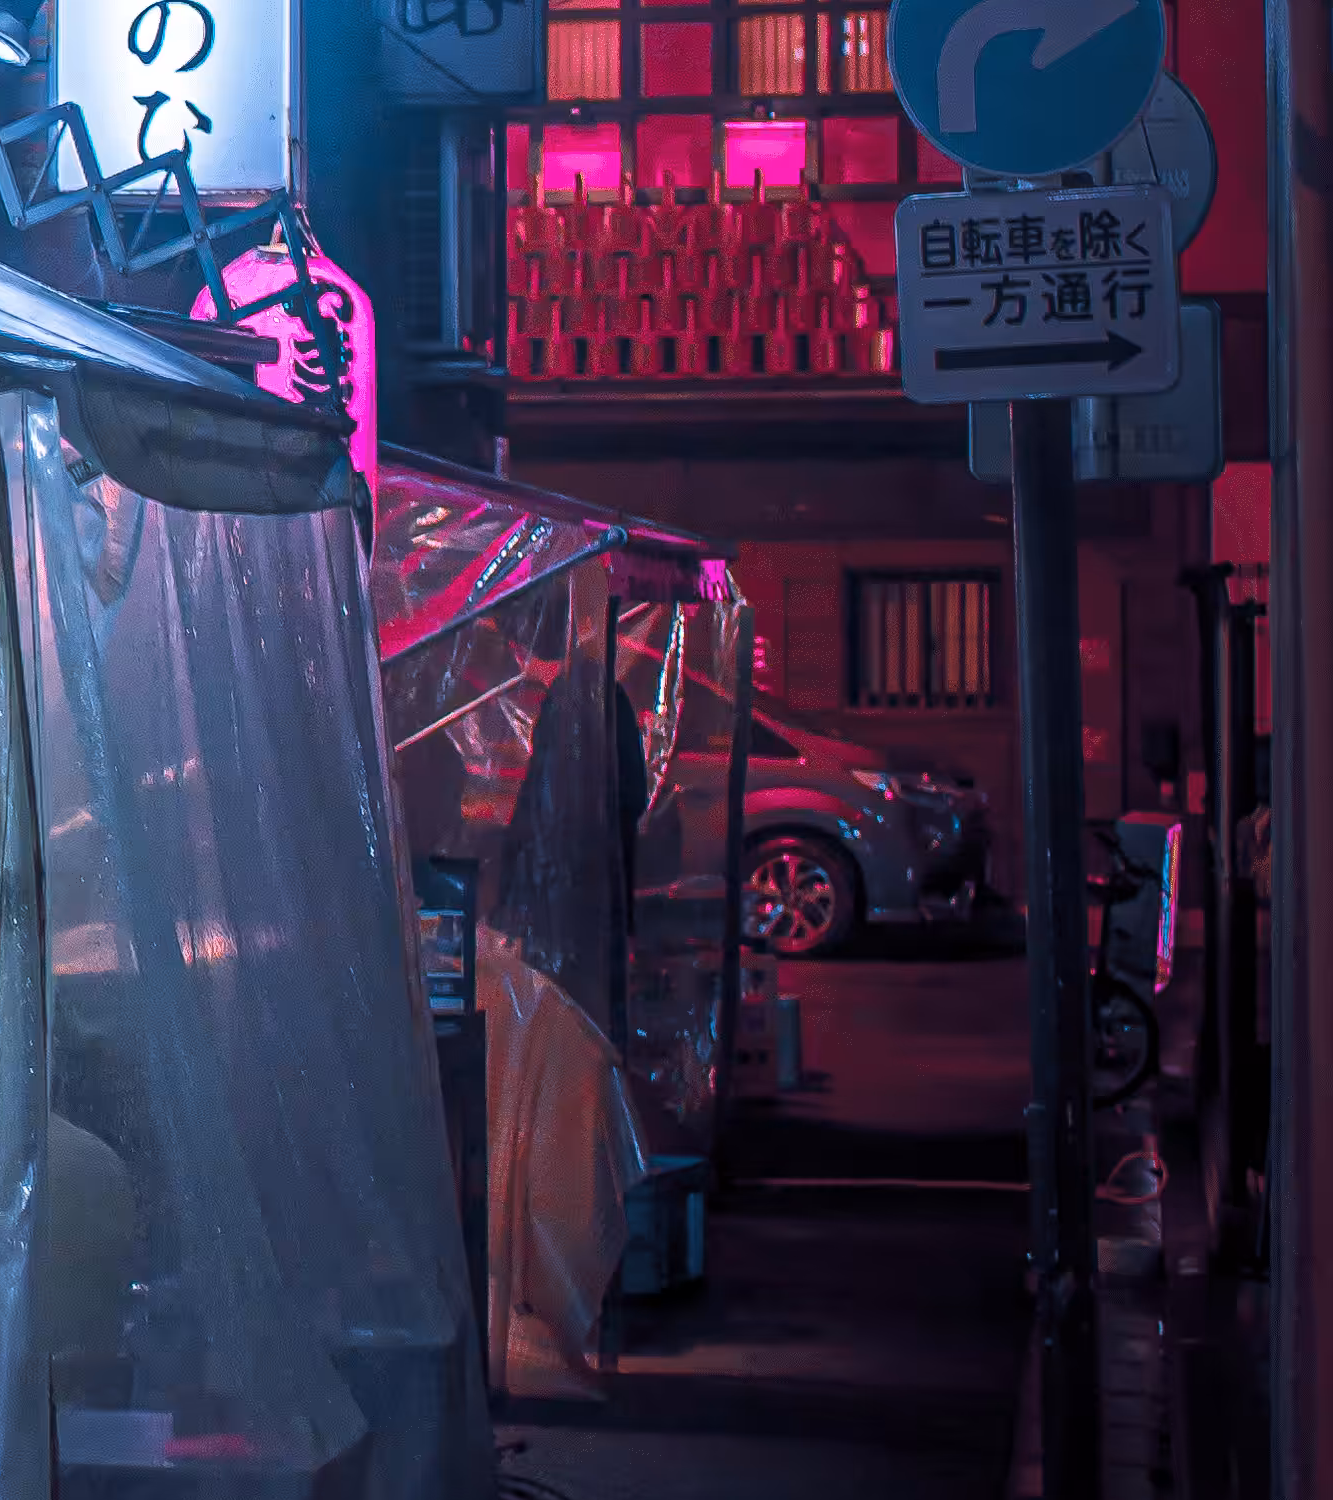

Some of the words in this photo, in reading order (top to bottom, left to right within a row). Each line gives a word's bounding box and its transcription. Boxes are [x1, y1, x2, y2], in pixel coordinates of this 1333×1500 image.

[920, 209, 1150, 268] 自転車を除く
[922, 269, 1153, 328] 一方通行
